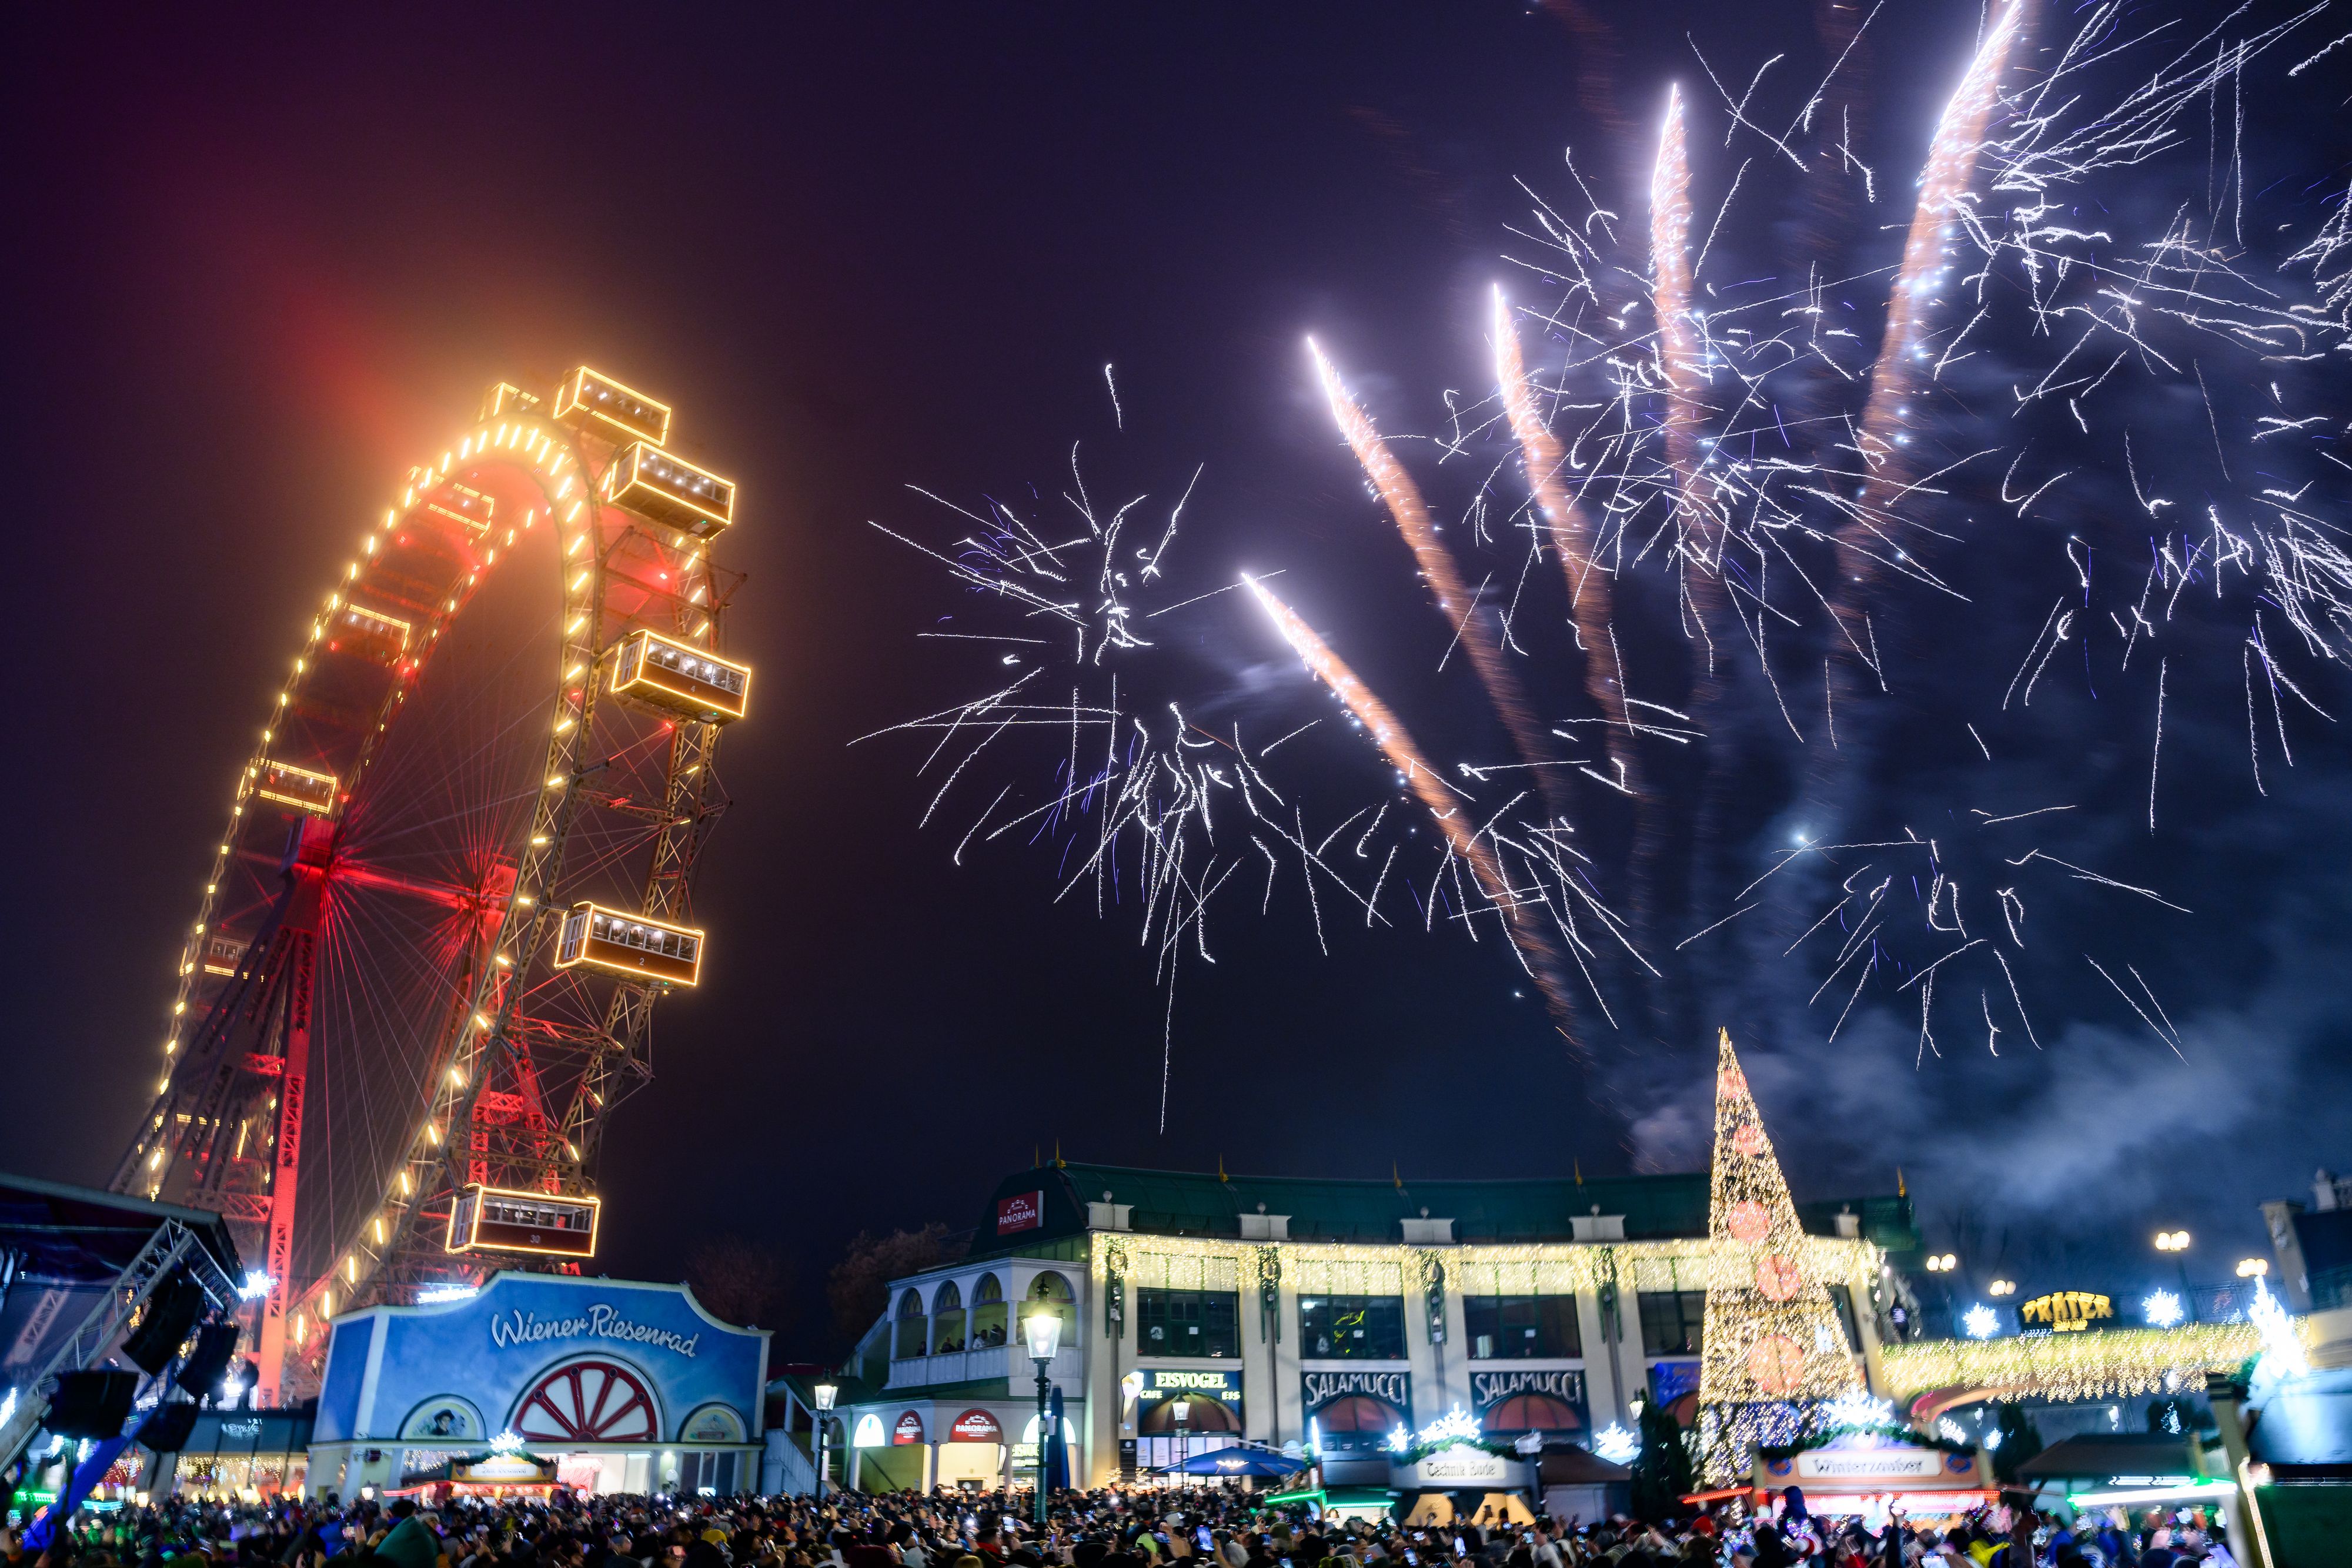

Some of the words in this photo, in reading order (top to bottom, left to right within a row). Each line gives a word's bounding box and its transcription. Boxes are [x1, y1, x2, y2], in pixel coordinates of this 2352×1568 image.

[639, 957, 644, 966] 2
[999, 1209, 1035, 1225] PANORAMA
[530, 1234, 540, 1243] 30
[2022, 1291, 2114, 1323] PRATER
[491, 1309, 589, 1349] Wiener
[588, 1303, 700, 1358] Riesenrad
[1155, 1372, 1228, 1389] EISVOGEL
[1305, 1372, 1406, 1406] SALAMUCCI
[1475, 1372, 1581, 1406] SALAMUCCI
[1221, 1391, 1241, 1400] EIS
